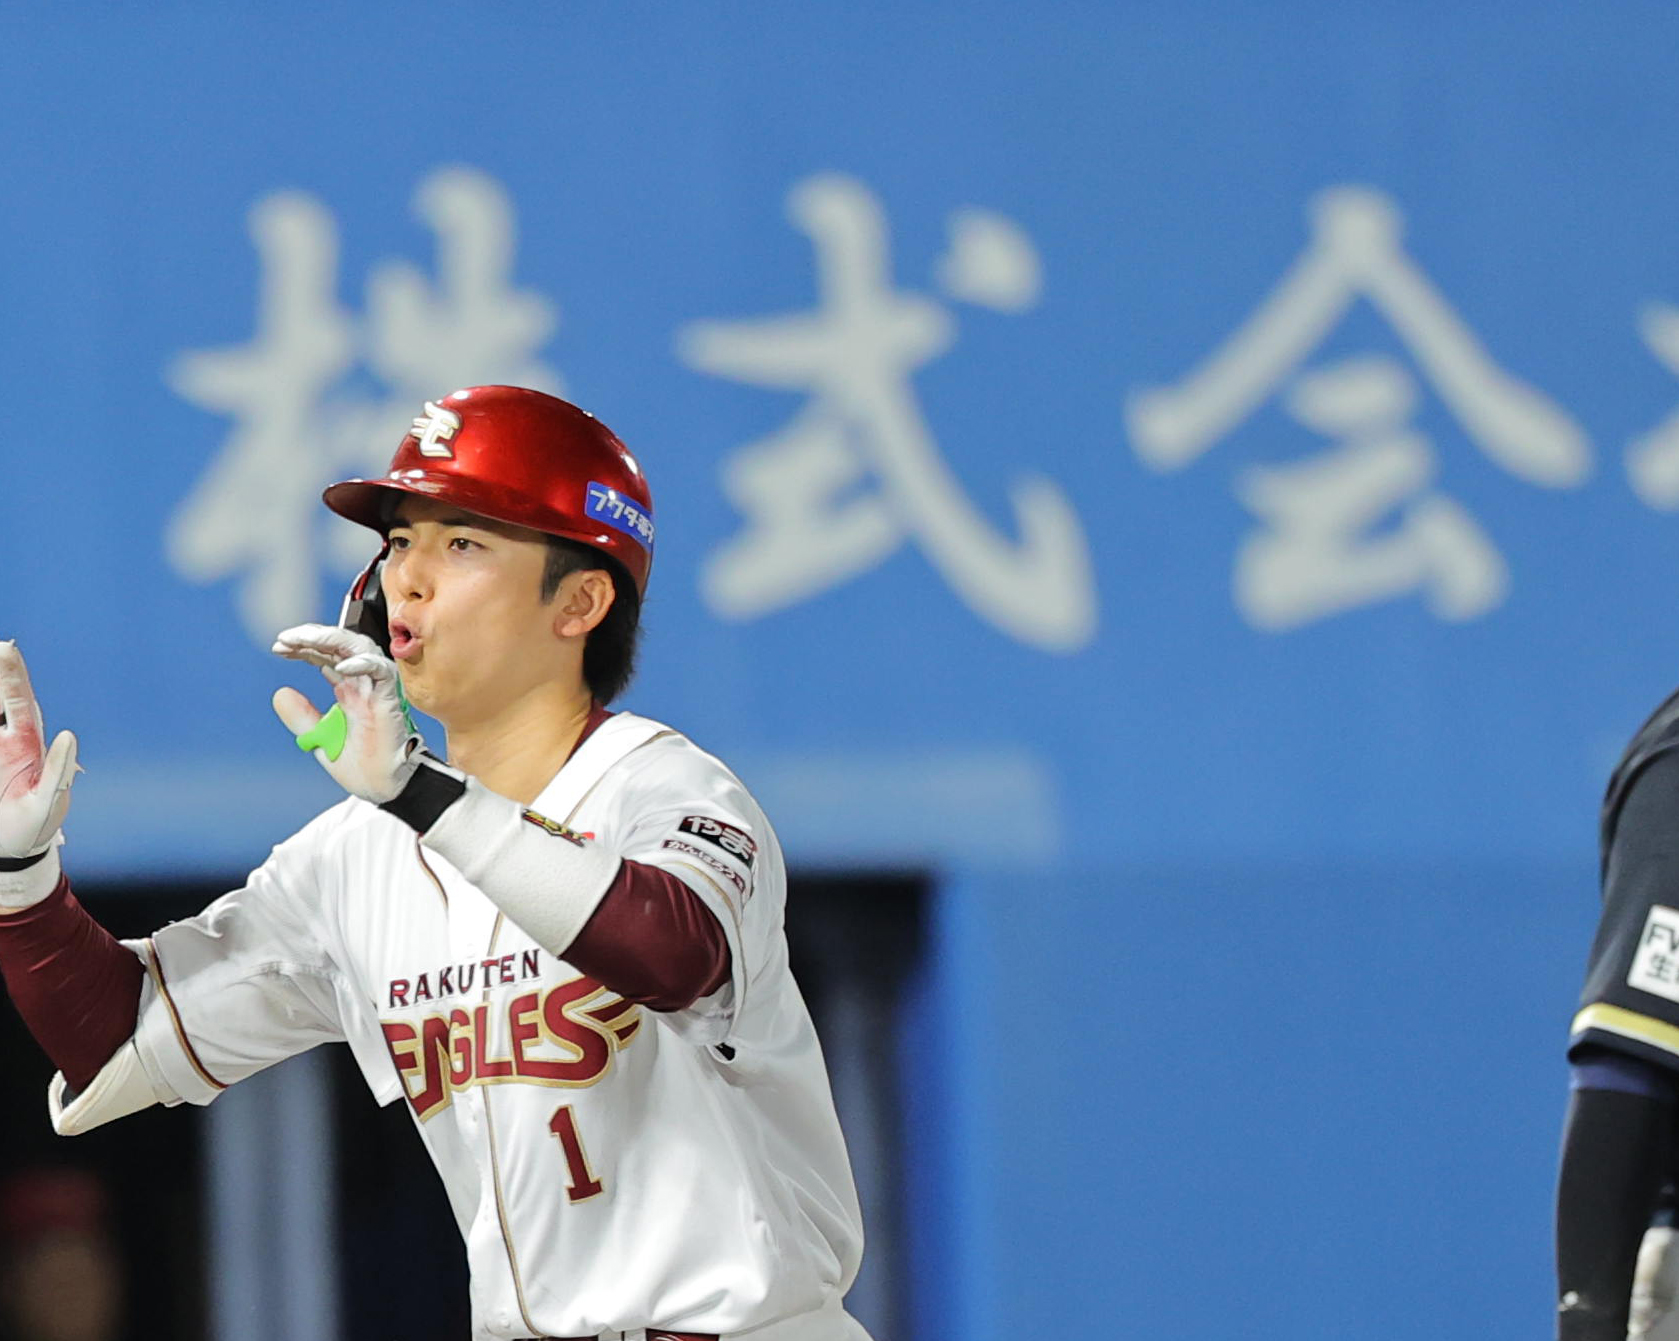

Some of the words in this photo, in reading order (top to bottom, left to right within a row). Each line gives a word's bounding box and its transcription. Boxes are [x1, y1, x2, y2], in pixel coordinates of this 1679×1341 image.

[165, 165, 1679, 655] 株式会
[686, 815, 754, 861] やま
[388, 948, 541, 1008] RAKUTEN
[378, 974, 620, 1124] EAGLES
[548, 1104, 604, 1206] 1
